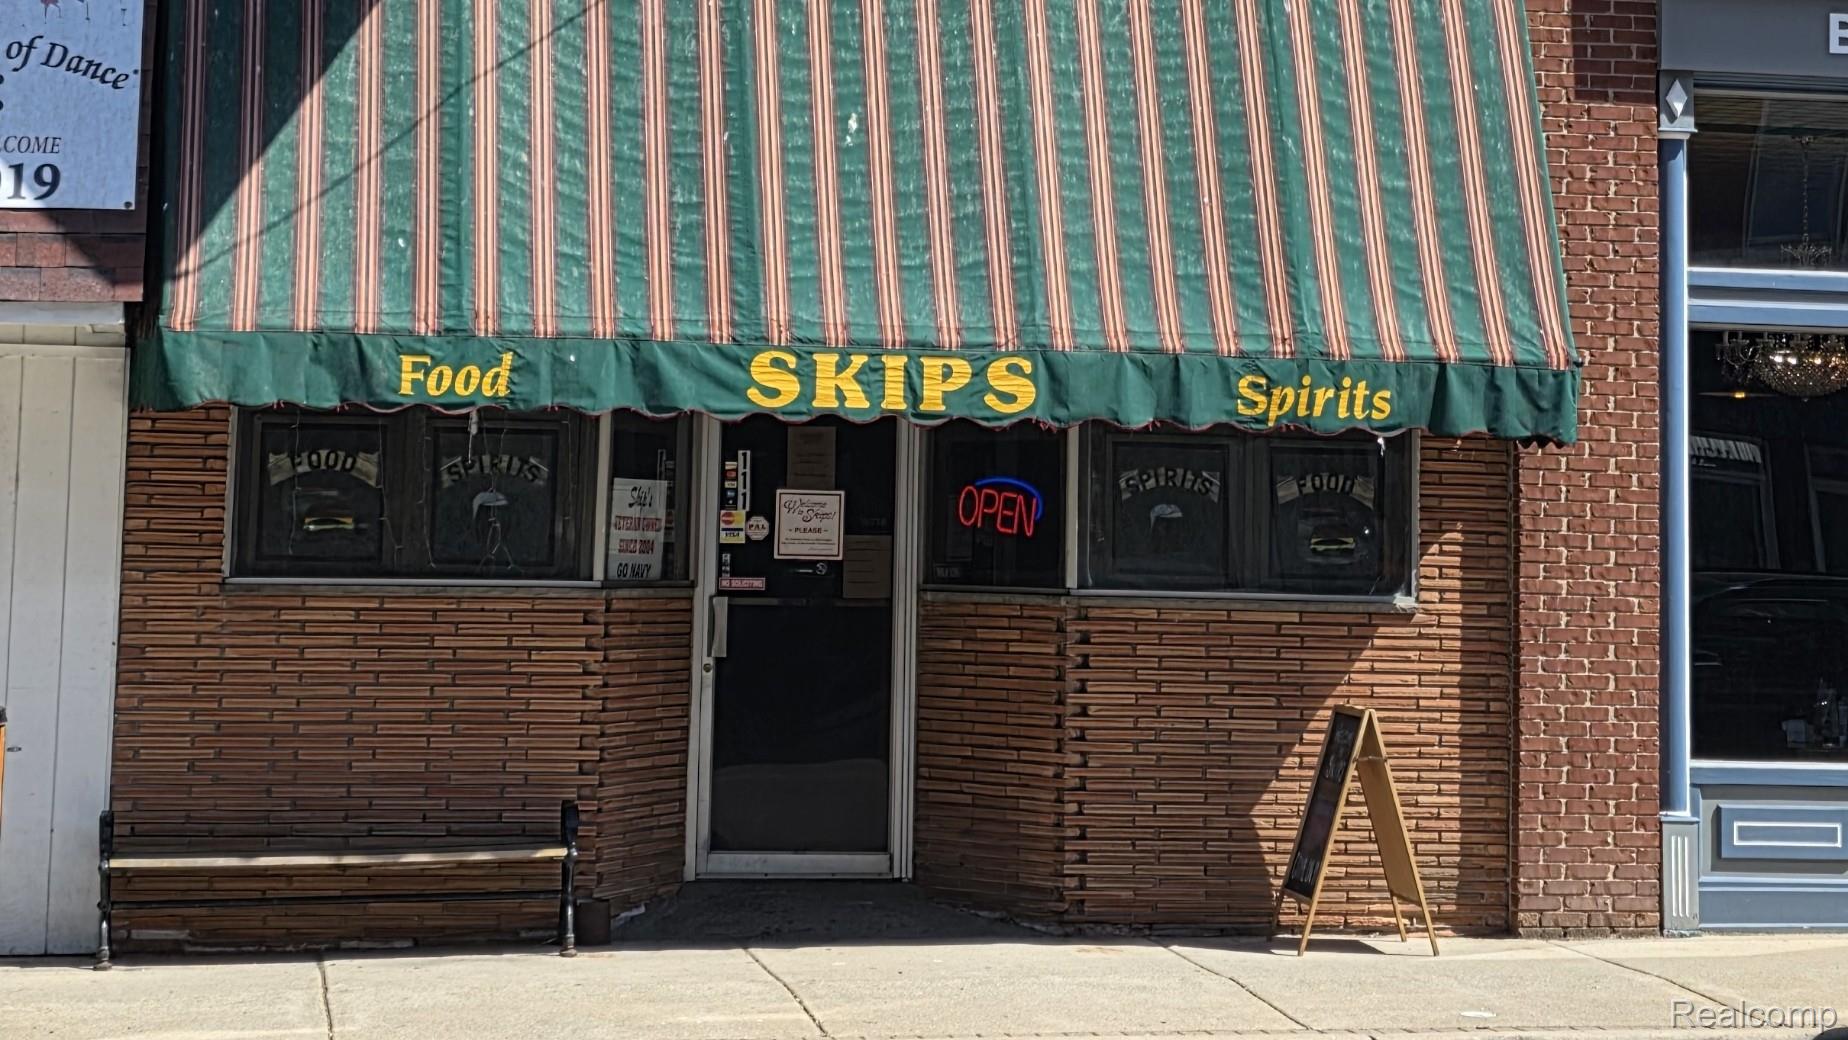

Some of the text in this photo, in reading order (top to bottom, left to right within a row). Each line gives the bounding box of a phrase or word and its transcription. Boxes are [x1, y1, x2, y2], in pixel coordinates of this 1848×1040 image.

[6, 35, 130, 90] of Dance
[0, 135, 62, 154] COME
[0, 162, 61, 200] 19
[398, 351, 514, 397] Food
[746, 350, 1037, 414] SKIPS
[1237, 374, 1392, 427] Spirits
[290, 449, 357, 472] FOOD
[446, 454, 541, 484] SPIRITS
[1125, 466, 1214, 495] SPIRITS
[1297, 472, 1356, 495] FOOD
[959, 486, 1037, 537] OPEN
[618, 538, 637, 554] SINCE
[616, 563, 652, 579] GO NAVY
